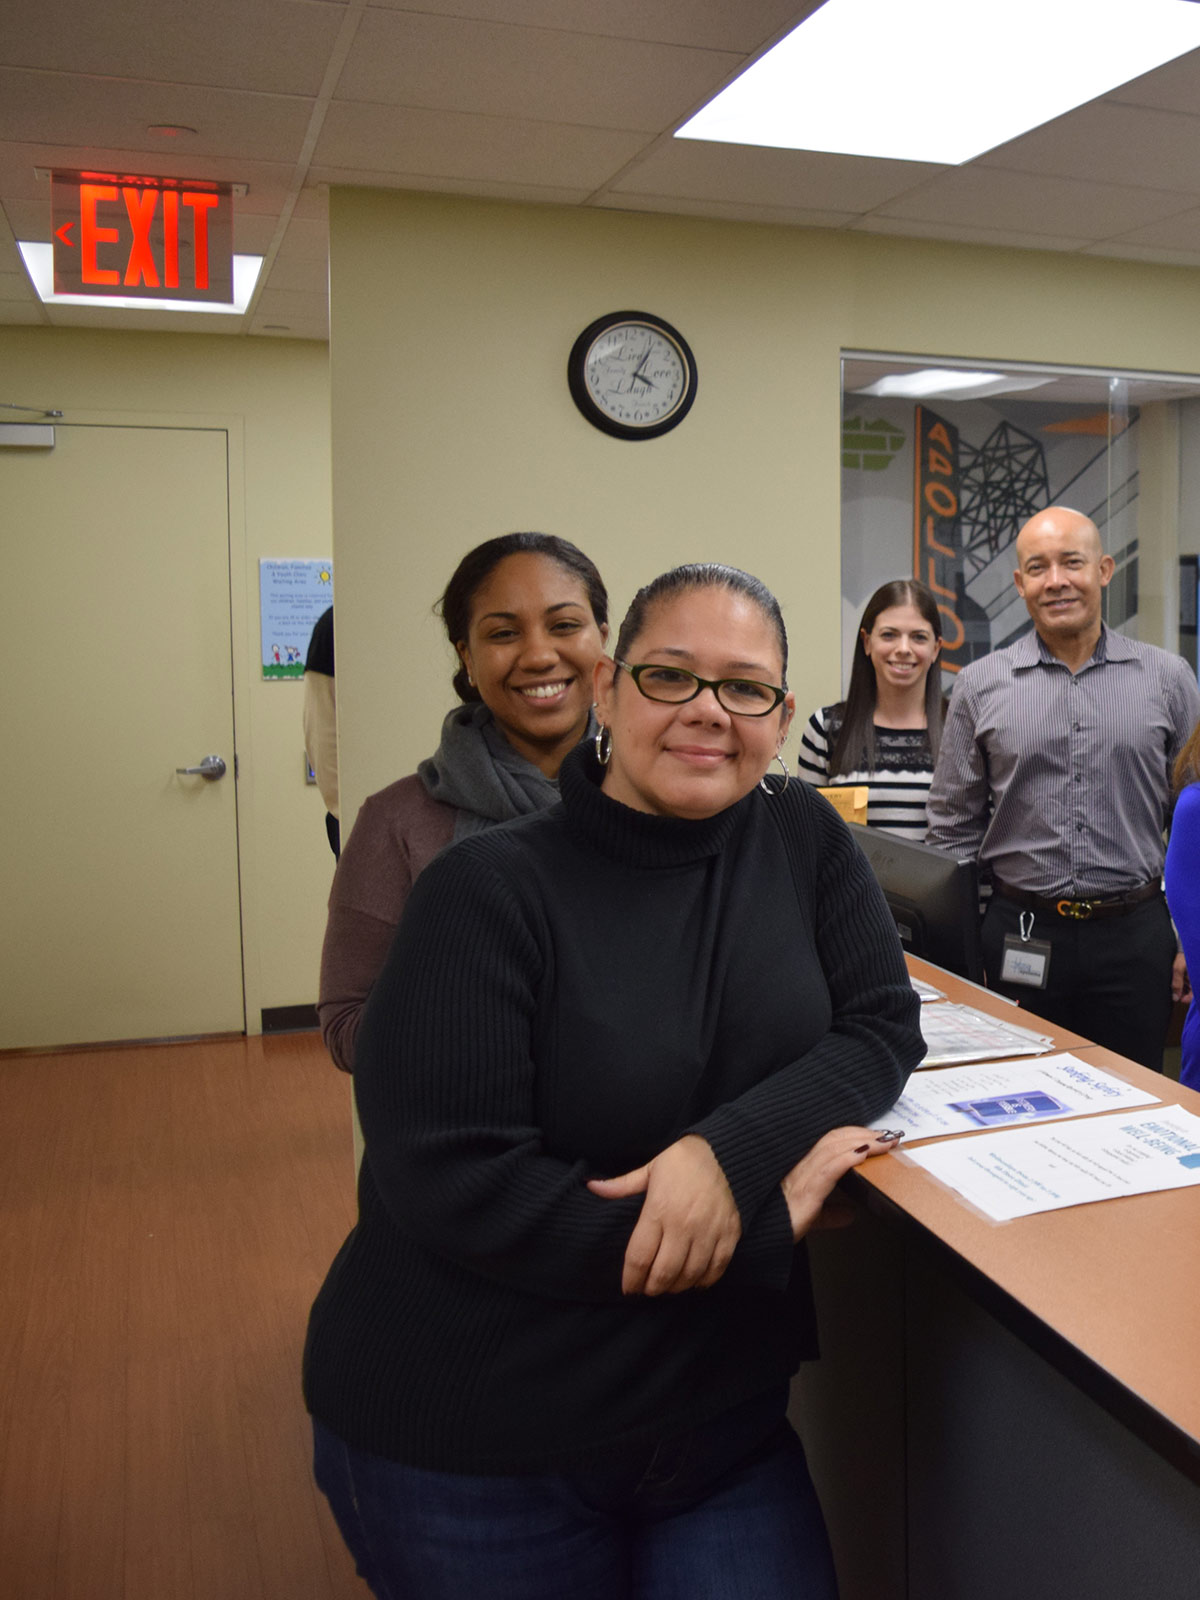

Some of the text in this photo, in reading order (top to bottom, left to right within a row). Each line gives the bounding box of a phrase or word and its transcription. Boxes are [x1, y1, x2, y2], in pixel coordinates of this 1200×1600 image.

[80, 184, 218, 290] EXIT
[924, 422, 965, 651] APOLLO
[1119, 1125, 1181, 1156] WELL-BEING
